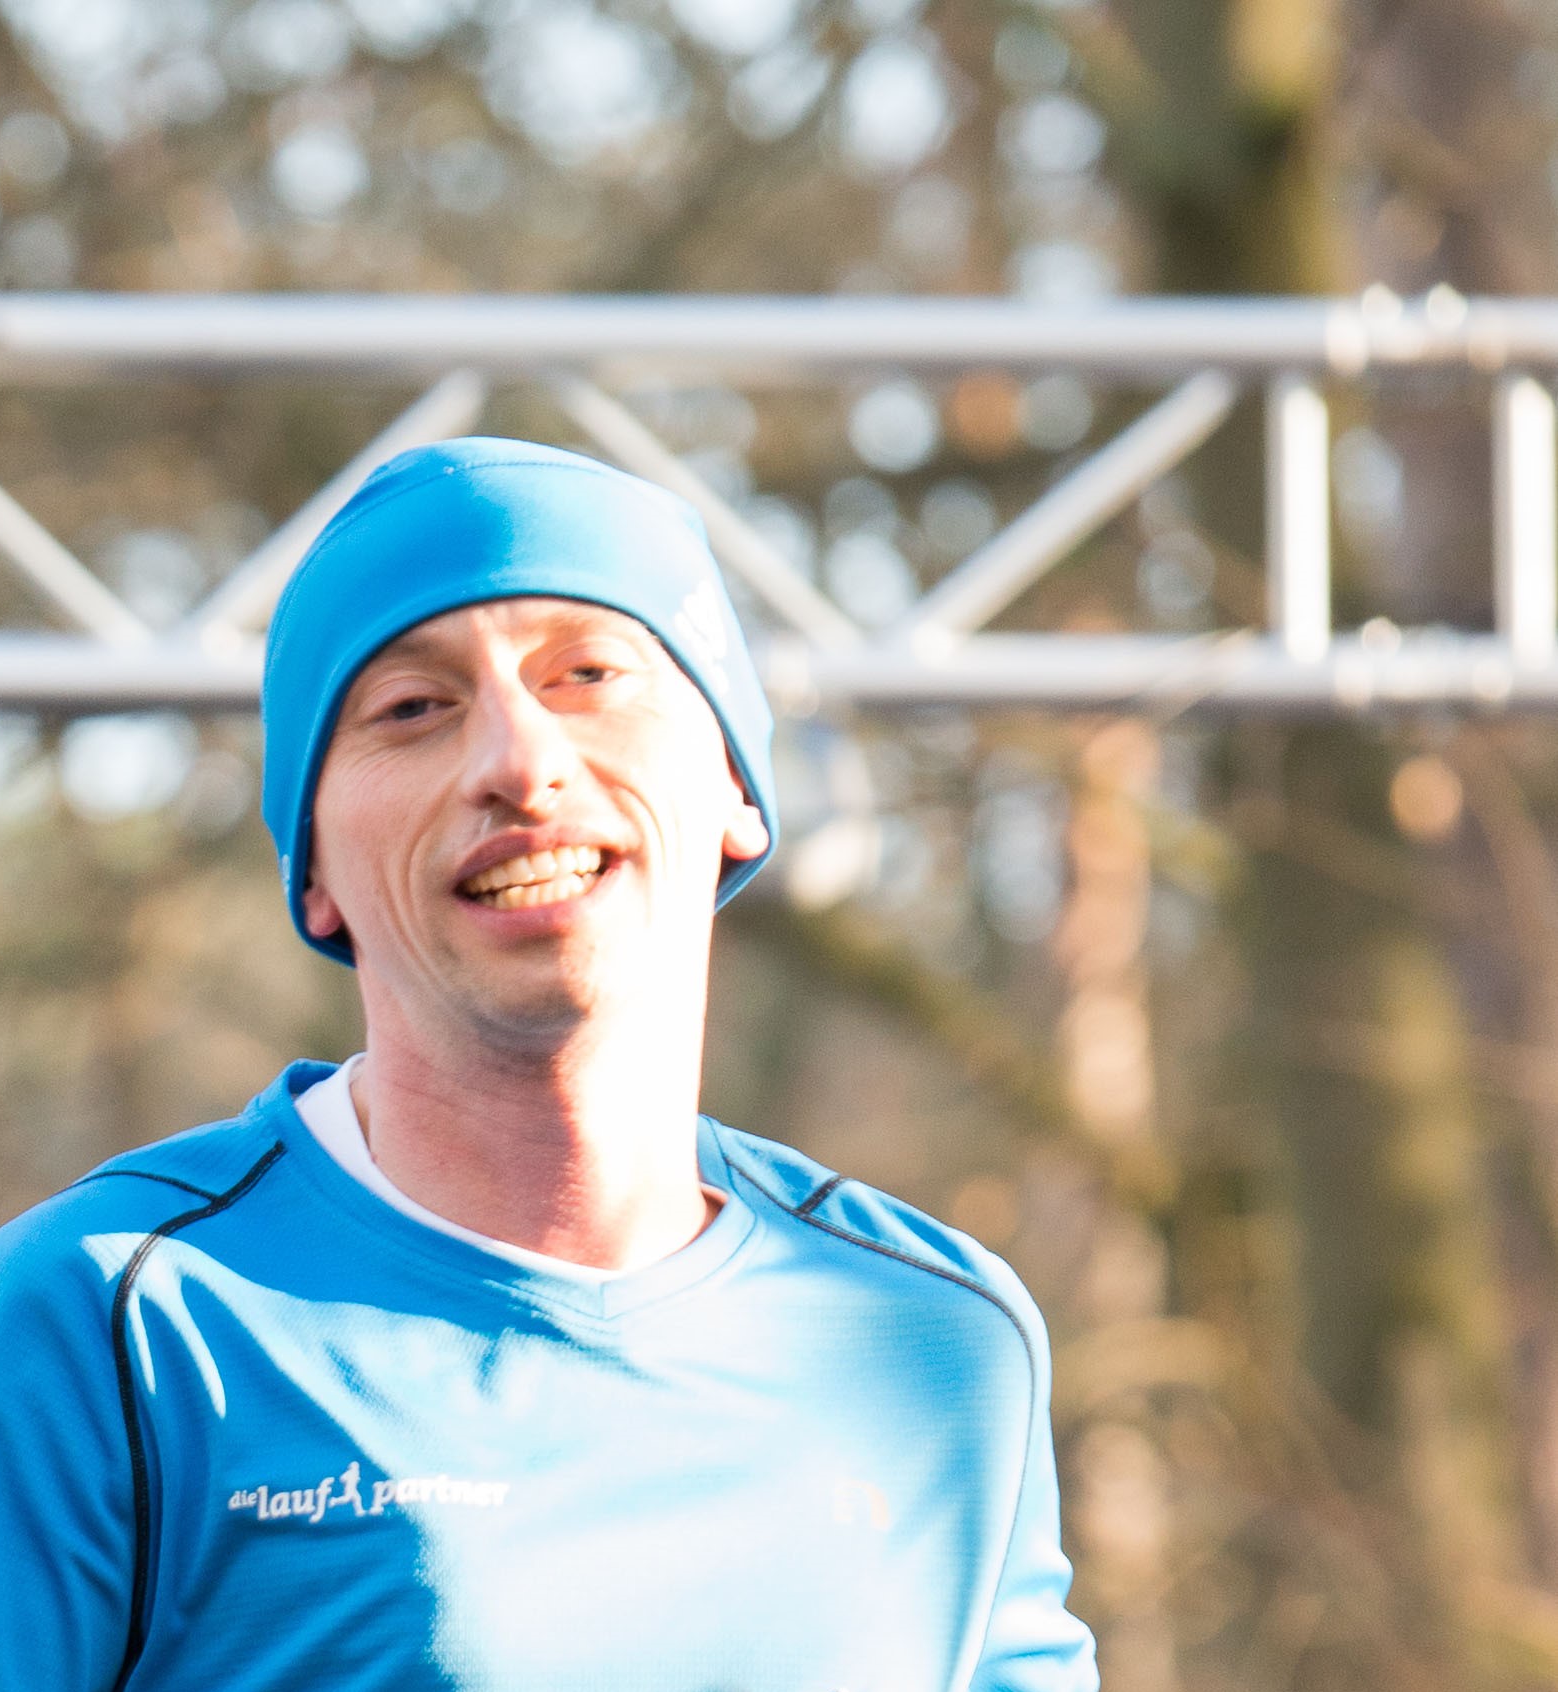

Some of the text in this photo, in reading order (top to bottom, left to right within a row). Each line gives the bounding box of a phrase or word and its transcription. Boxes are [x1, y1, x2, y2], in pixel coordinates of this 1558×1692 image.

[227, 1473, 512, 1524] die lauf partner
